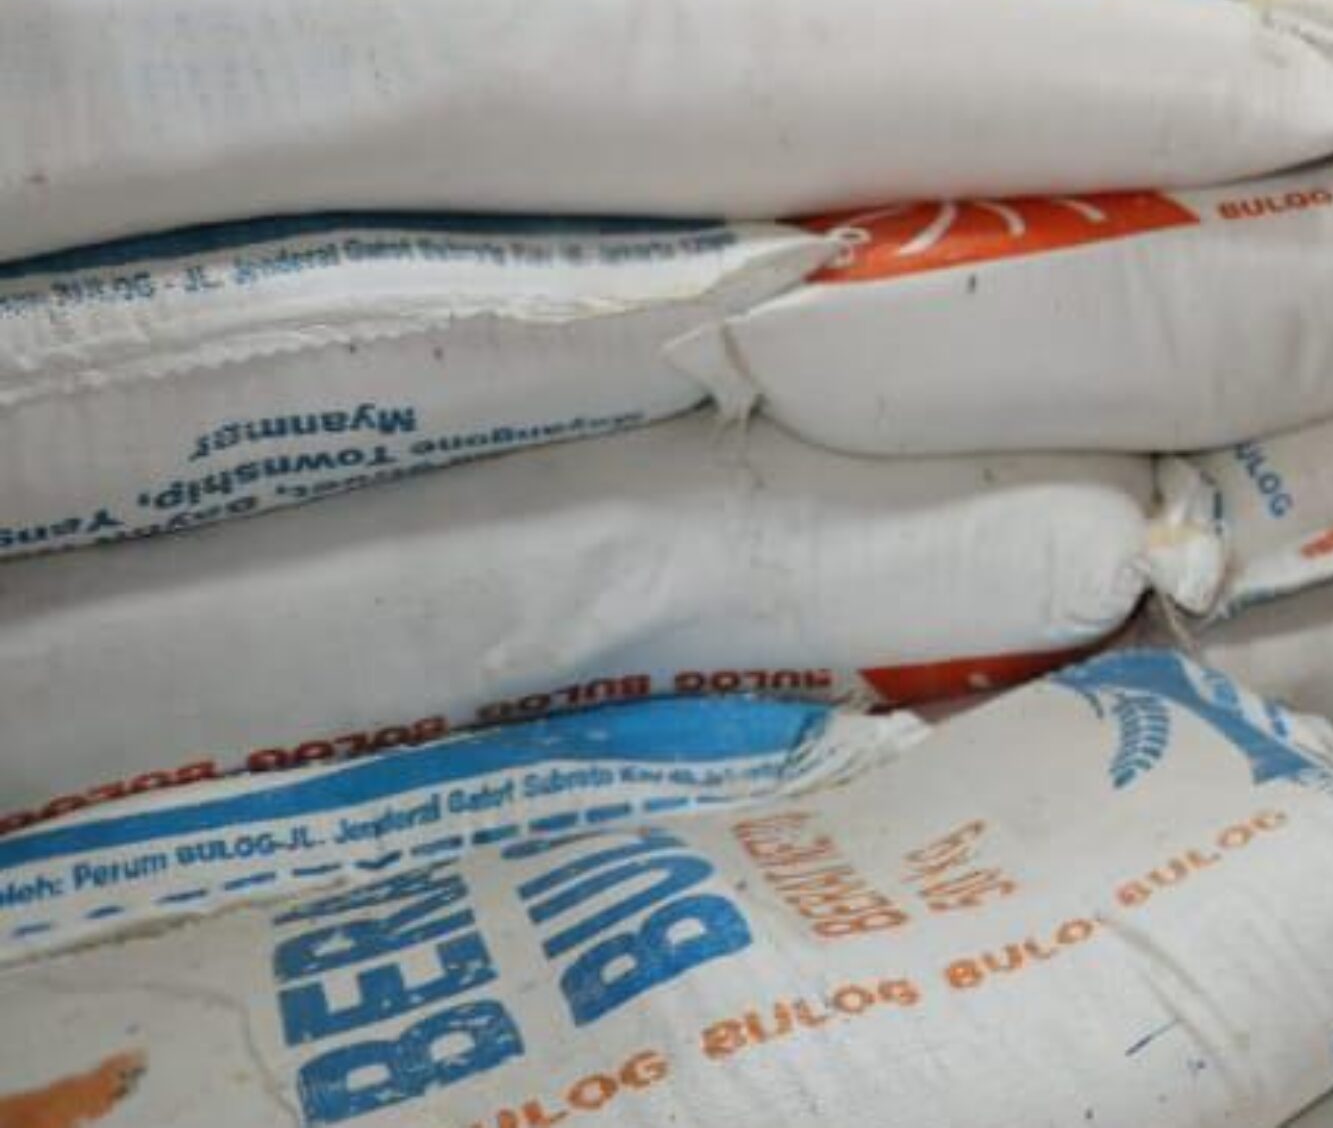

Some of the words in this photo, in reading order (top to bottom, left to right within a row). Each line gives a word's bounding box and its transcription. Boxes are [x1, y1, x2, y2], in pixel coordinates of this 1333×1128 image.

[1218, 189, 1333, 222] BULOG
[136, 444, 398, 509] Township,
[1235, 442, 1295, 522] ULOG
[73, 852, 168, 890] Perum
[474, 1048, 669, 1128] ULOG
[701, 975, 920, 1062] BULOG
[944, 912, 1103, 993] BULO
[1114, 806, 1290, 909] BULOG
